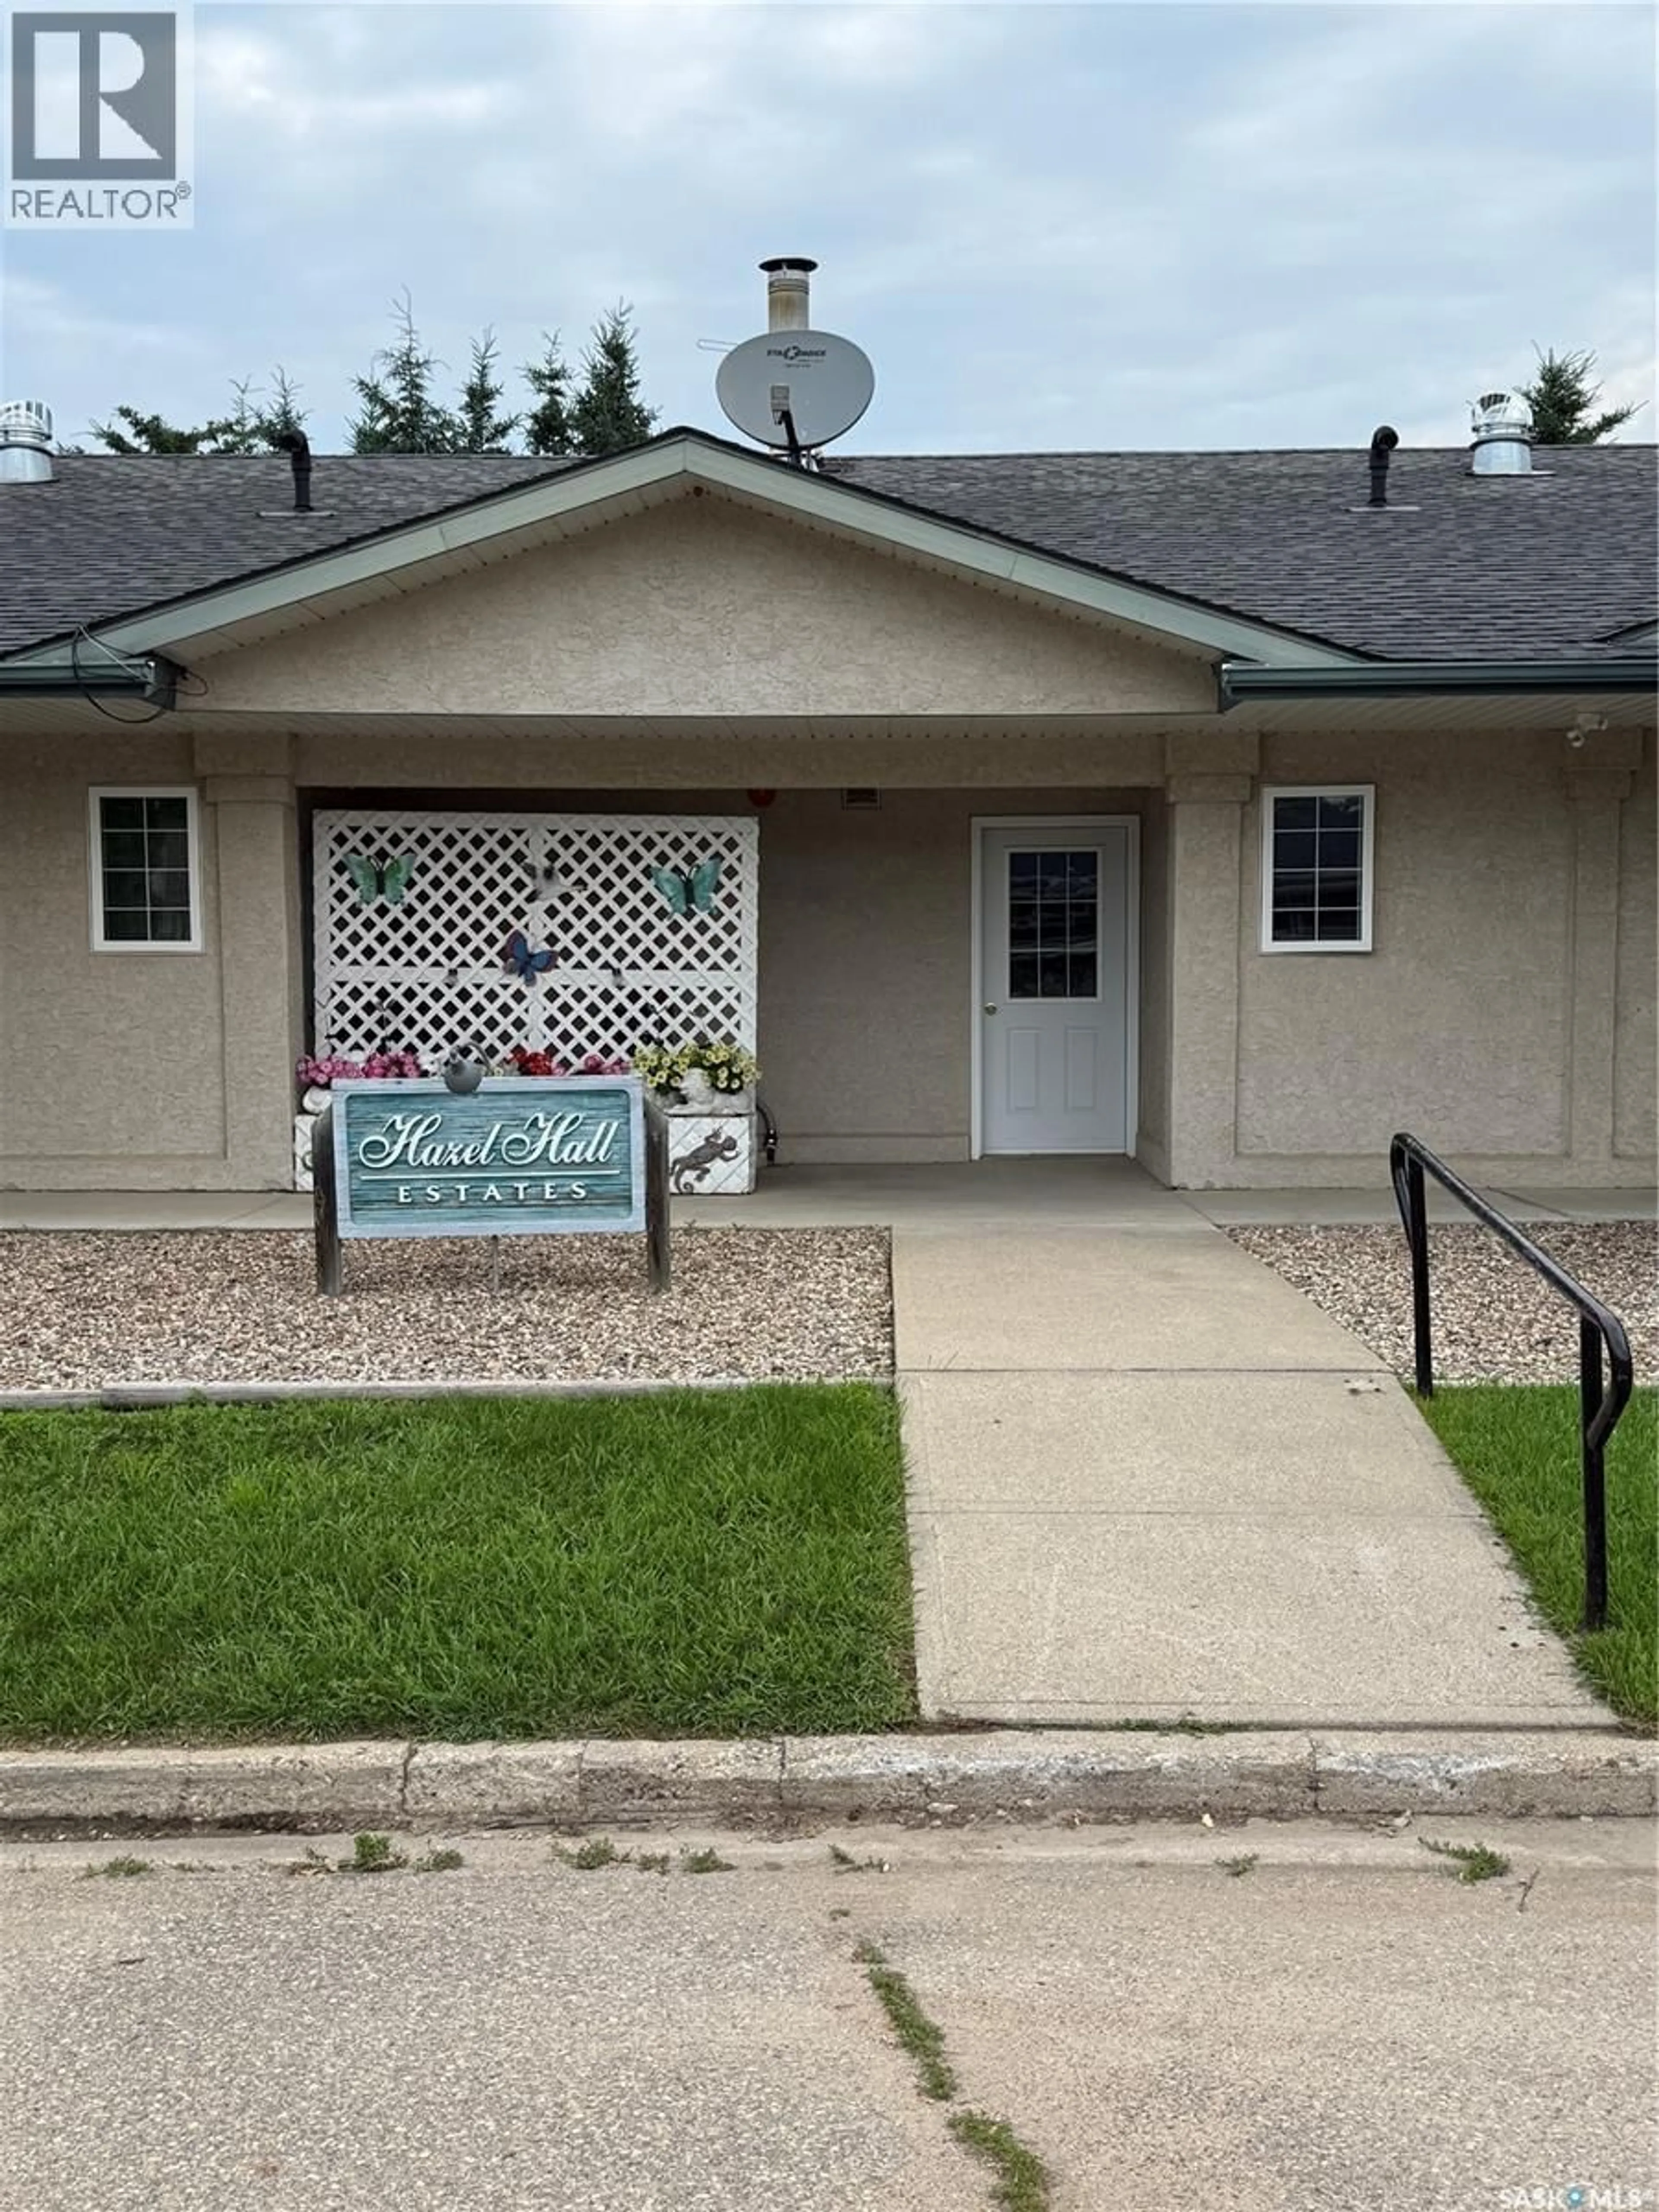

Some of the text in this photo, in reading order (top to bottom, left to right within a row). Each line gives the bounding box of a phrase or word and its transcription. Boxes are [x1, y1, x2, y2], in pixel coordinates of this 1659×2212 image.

[359, 1111, 618, 1167] Hazel Hall
[398, 1181, 588, 1203] ESTATES
